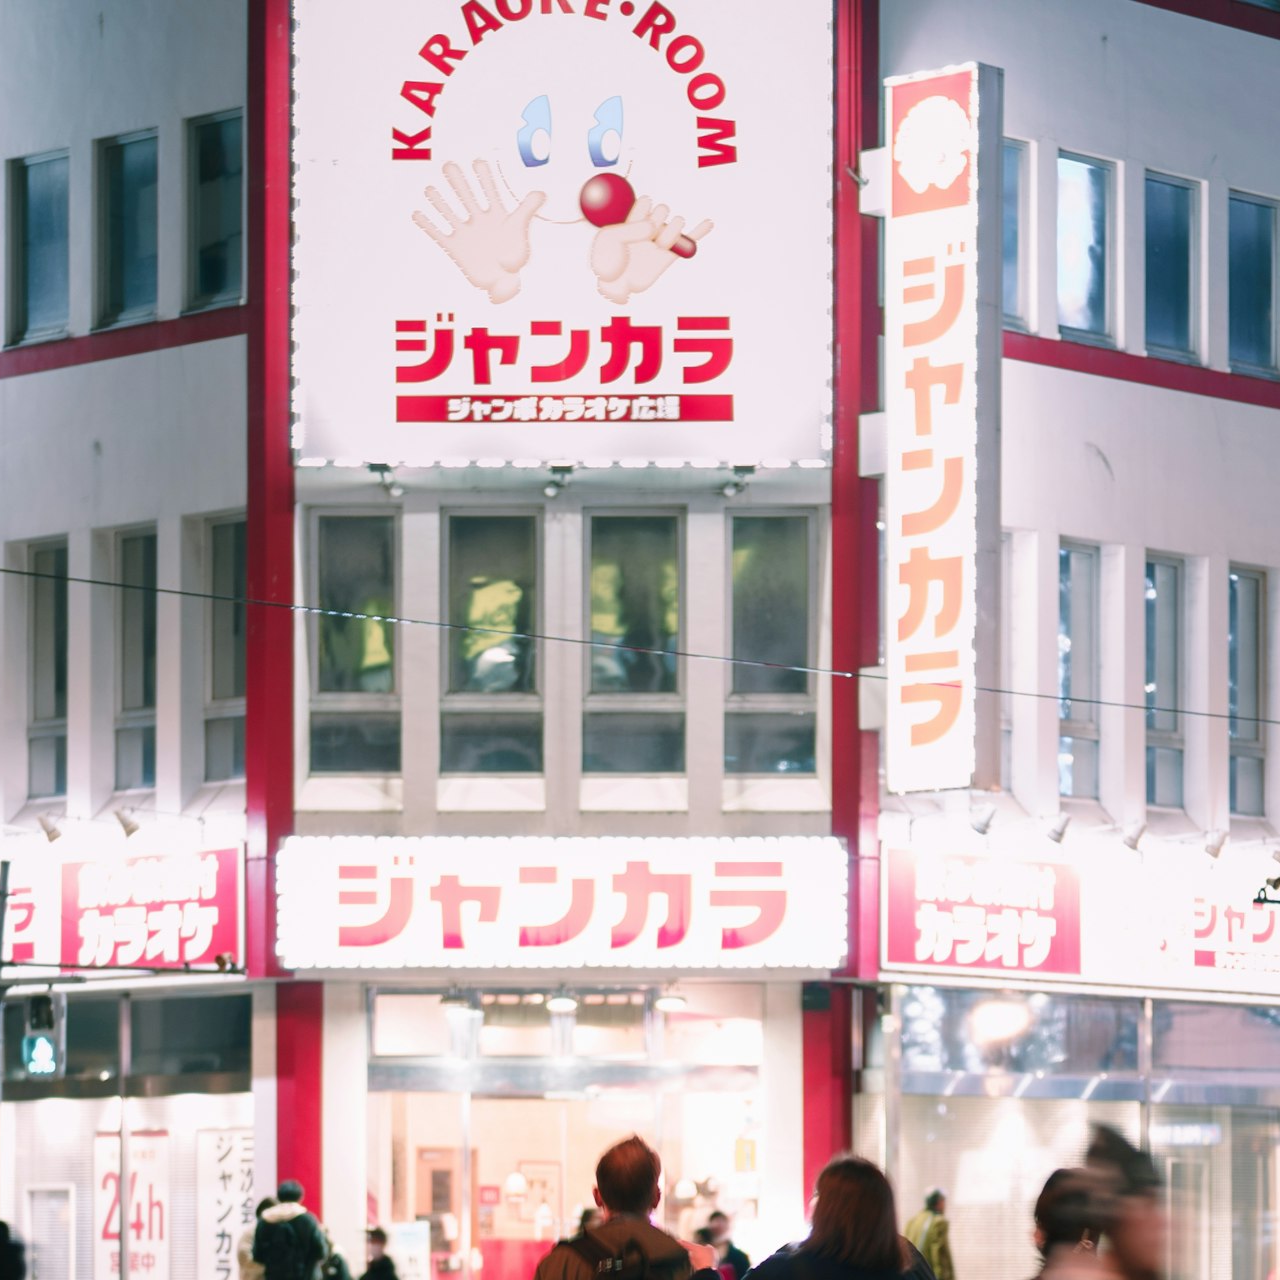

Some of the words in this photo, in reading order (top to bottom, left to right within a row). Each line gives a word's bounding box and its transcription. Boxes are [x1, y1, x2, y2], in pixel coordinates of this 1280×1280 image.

[395, 312, 734, 385] ジャンカラ
[898, 241, 966, 748] ジャンカラ
[78, 902, 219, 966] カラオケ
[338, 855, 787, 950] ジャンカラ
[915, 903, 1056, 968] カラオケ
